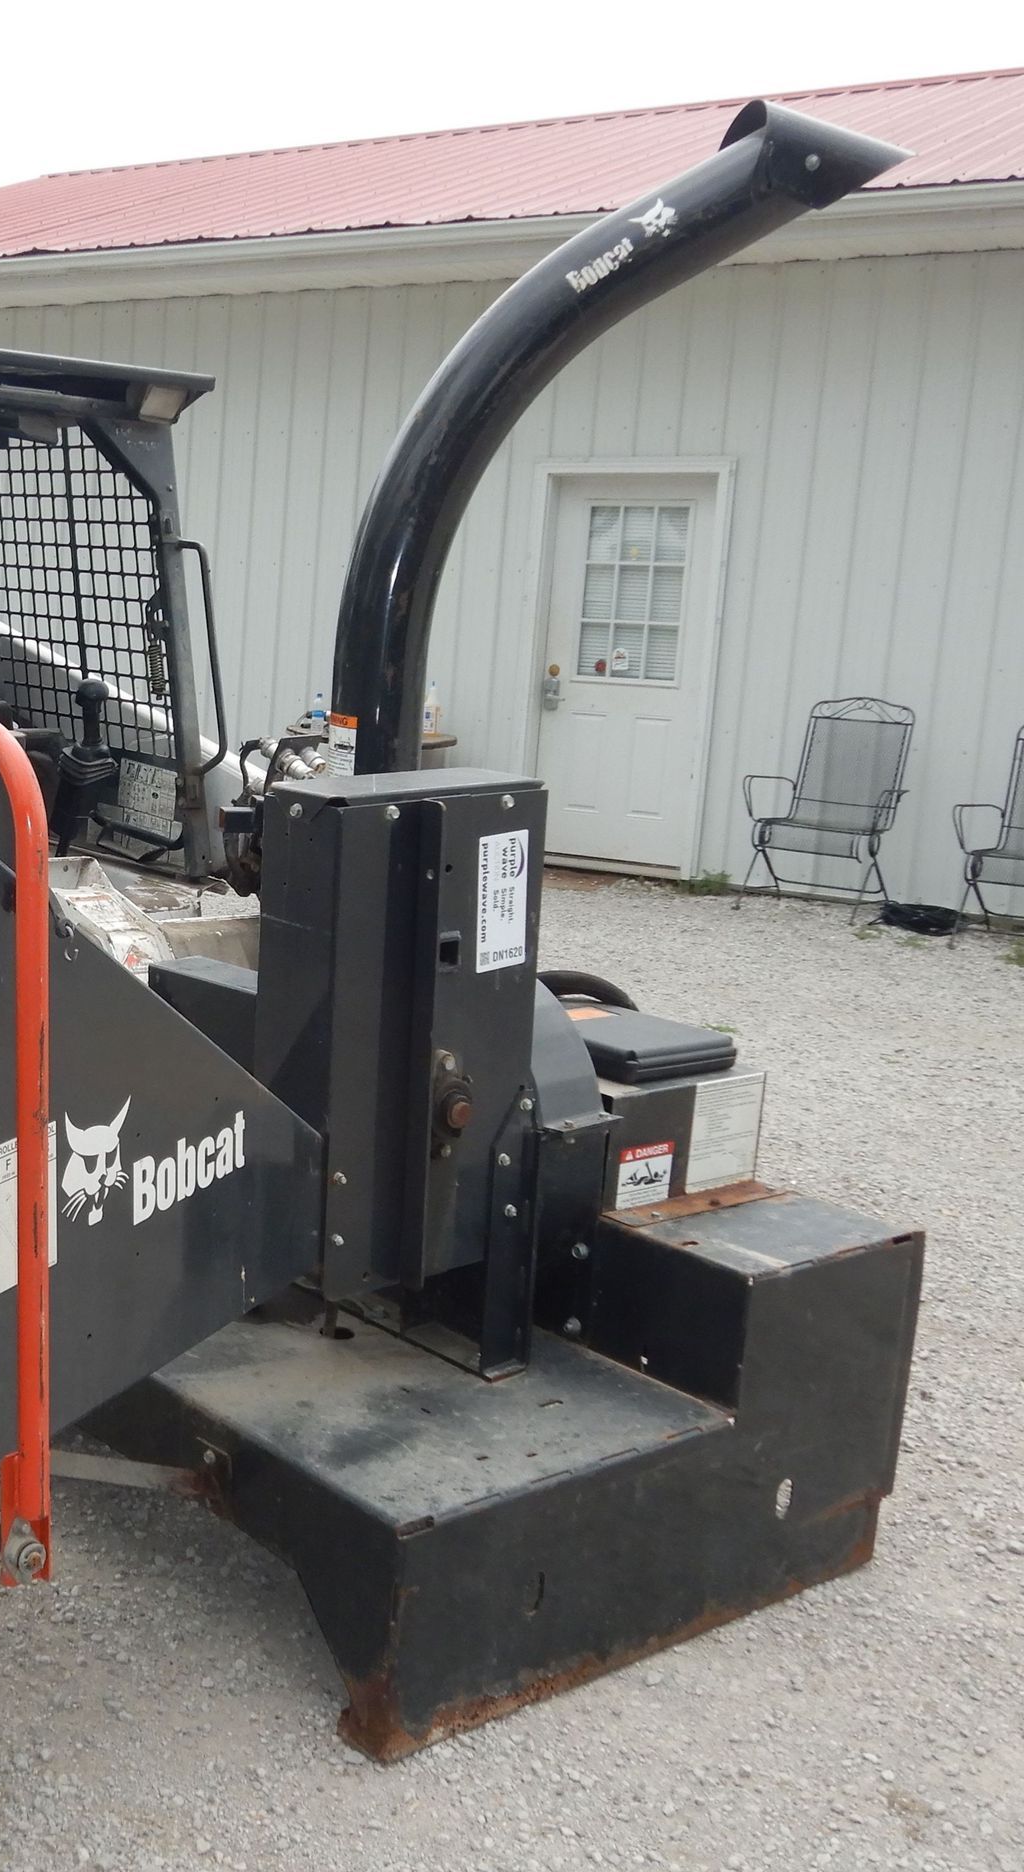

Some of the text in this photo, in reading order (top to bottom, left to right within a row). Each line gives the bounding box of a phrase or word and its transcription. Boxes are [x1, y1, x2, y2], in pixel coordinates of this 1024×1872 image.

[501, 846, 509, 879] wave
[508, 837, 518, 878] purple
[480, 842, 490, 944] purplewave.com
[492, 889, 500, 913] Sold.
[500, 887, 508, 921] Simple.
[507, 886, 516, 925] Straight.
[492, 945, 524, 963] DN1620
[5, 1158, 12, 1172] F
[635, 1143, 669, 1159] DANGER
[133, 1110, 246, 1227] Bobcat
